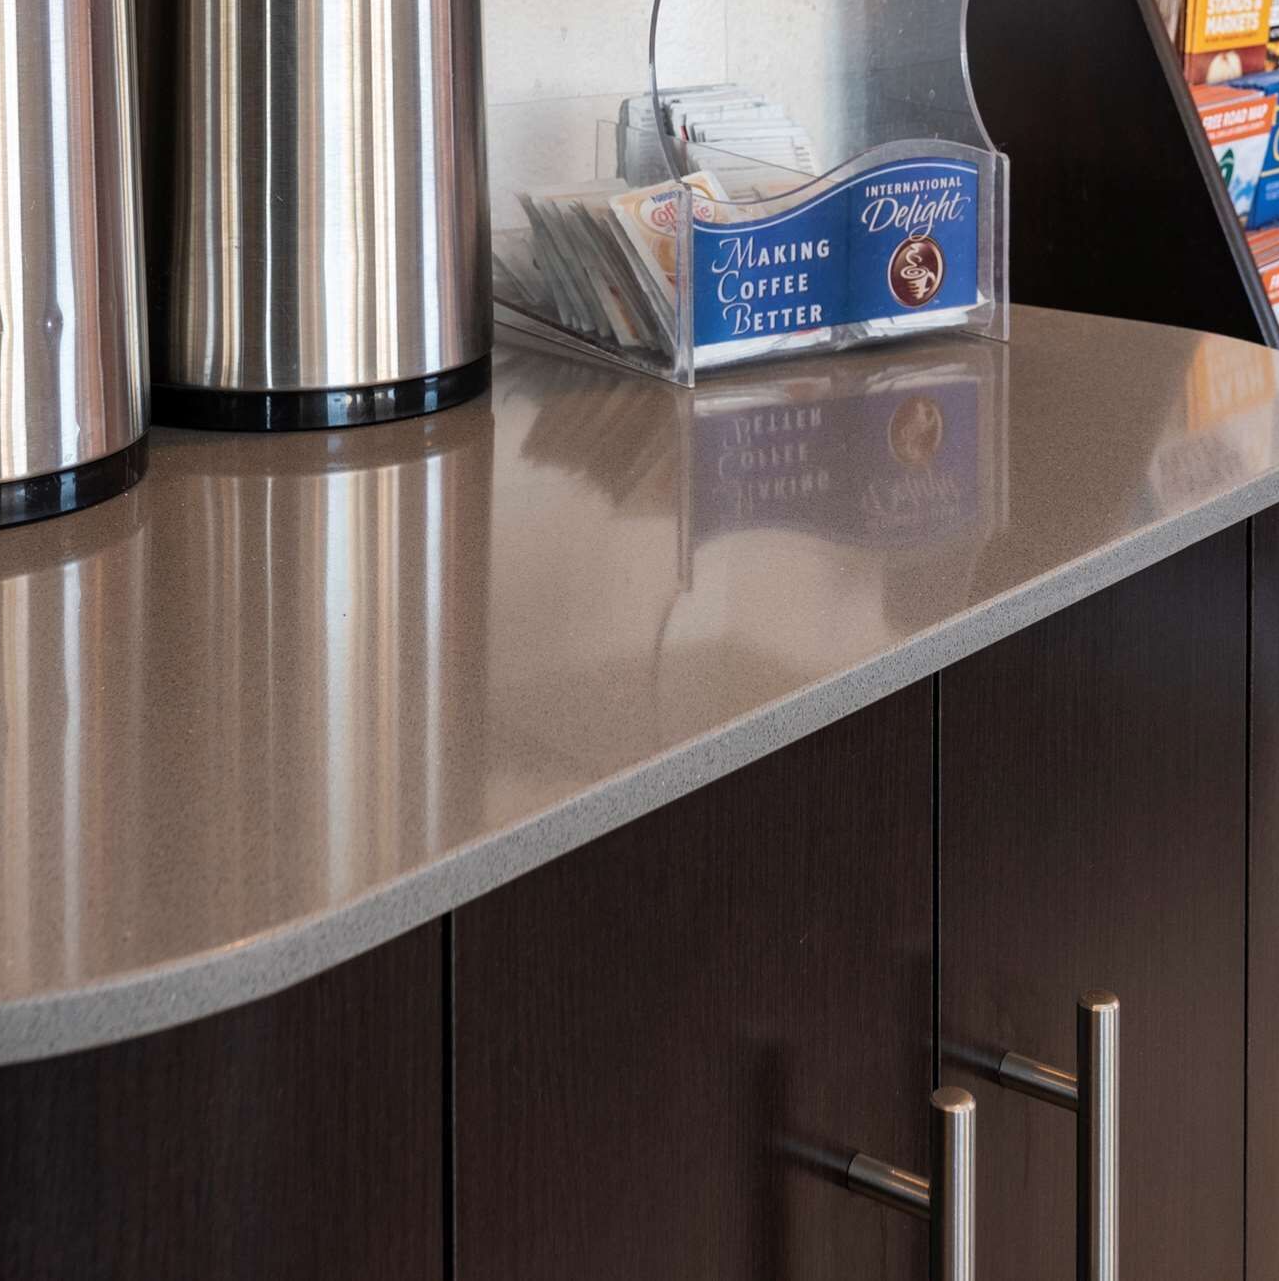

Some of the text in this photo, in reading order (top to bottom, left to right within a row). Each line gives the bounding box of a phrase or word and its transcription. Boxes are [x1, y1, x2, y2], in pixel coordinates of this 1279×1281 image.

[865, 176, 963, 198] INTERNATIONAL
[861, 191, 971, 242] Delight
[711, 235, 831, 274] MAKING
[718, 270, 809, 304] COFFEE
[722, 302, 823, 335] BETTER
